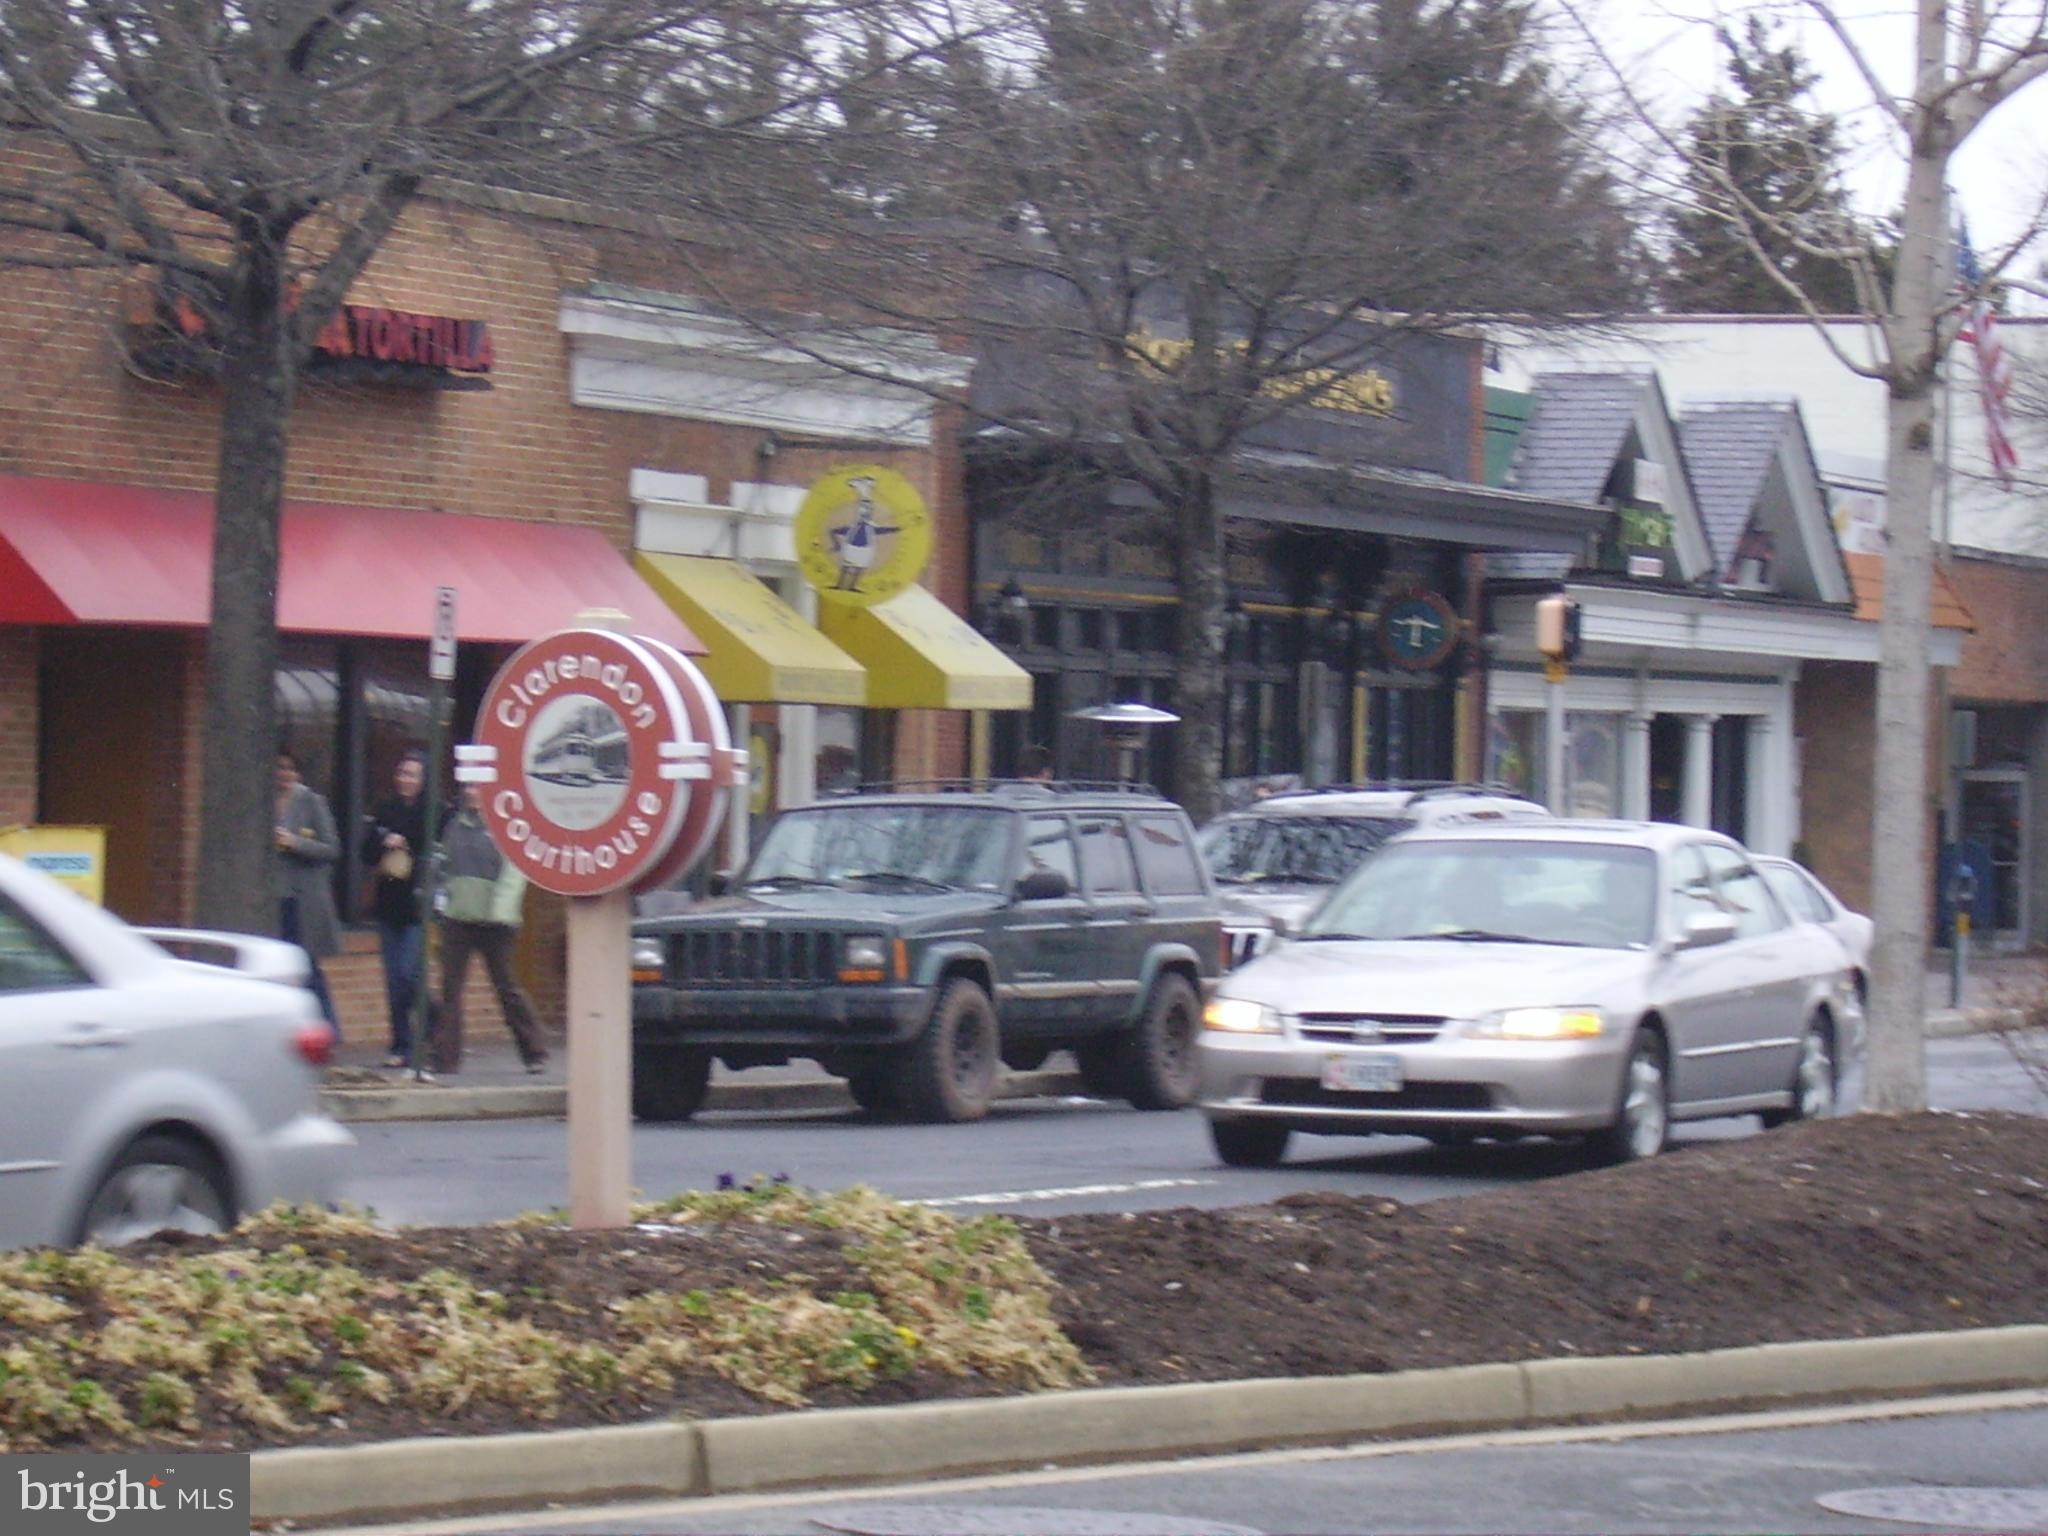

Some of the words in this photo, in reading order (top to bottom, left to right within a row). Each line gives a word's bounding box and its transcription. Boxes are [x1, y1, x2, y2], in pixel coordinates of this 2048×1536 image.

[349, 305, 493, 372] TORTILLA
[496, 654, 657, 729] Clarendon
[493, 789, 663, 876] Courthouse
